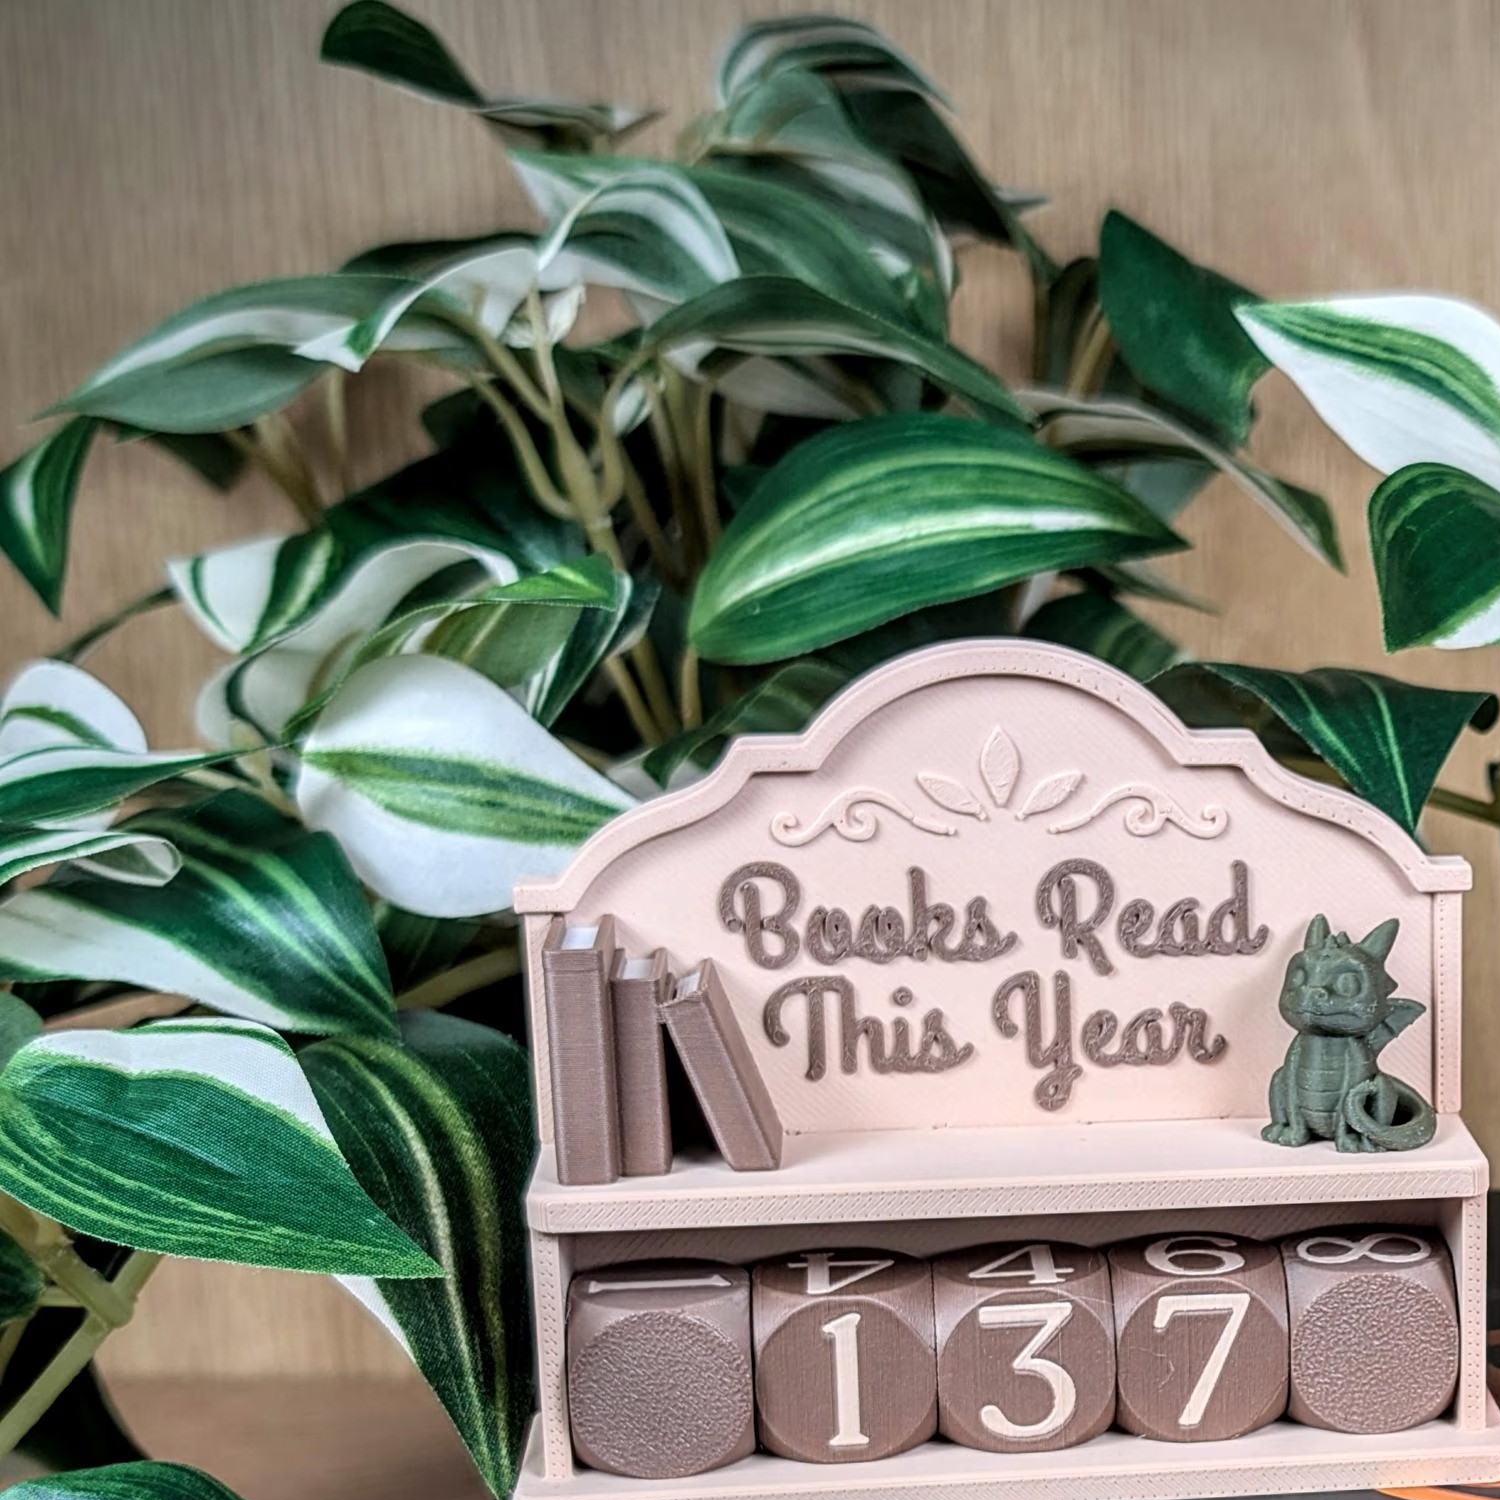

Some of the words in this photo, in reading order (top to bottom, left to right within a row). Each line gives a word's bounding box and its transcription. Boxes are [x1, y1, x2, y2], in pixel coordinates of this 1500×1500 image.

[717, 860, 1017, 970] Books
[1036, 858, 1269, 976] Read
[763, 975, 974, 1082] This
[992, 970, 1227, 1112] Year
